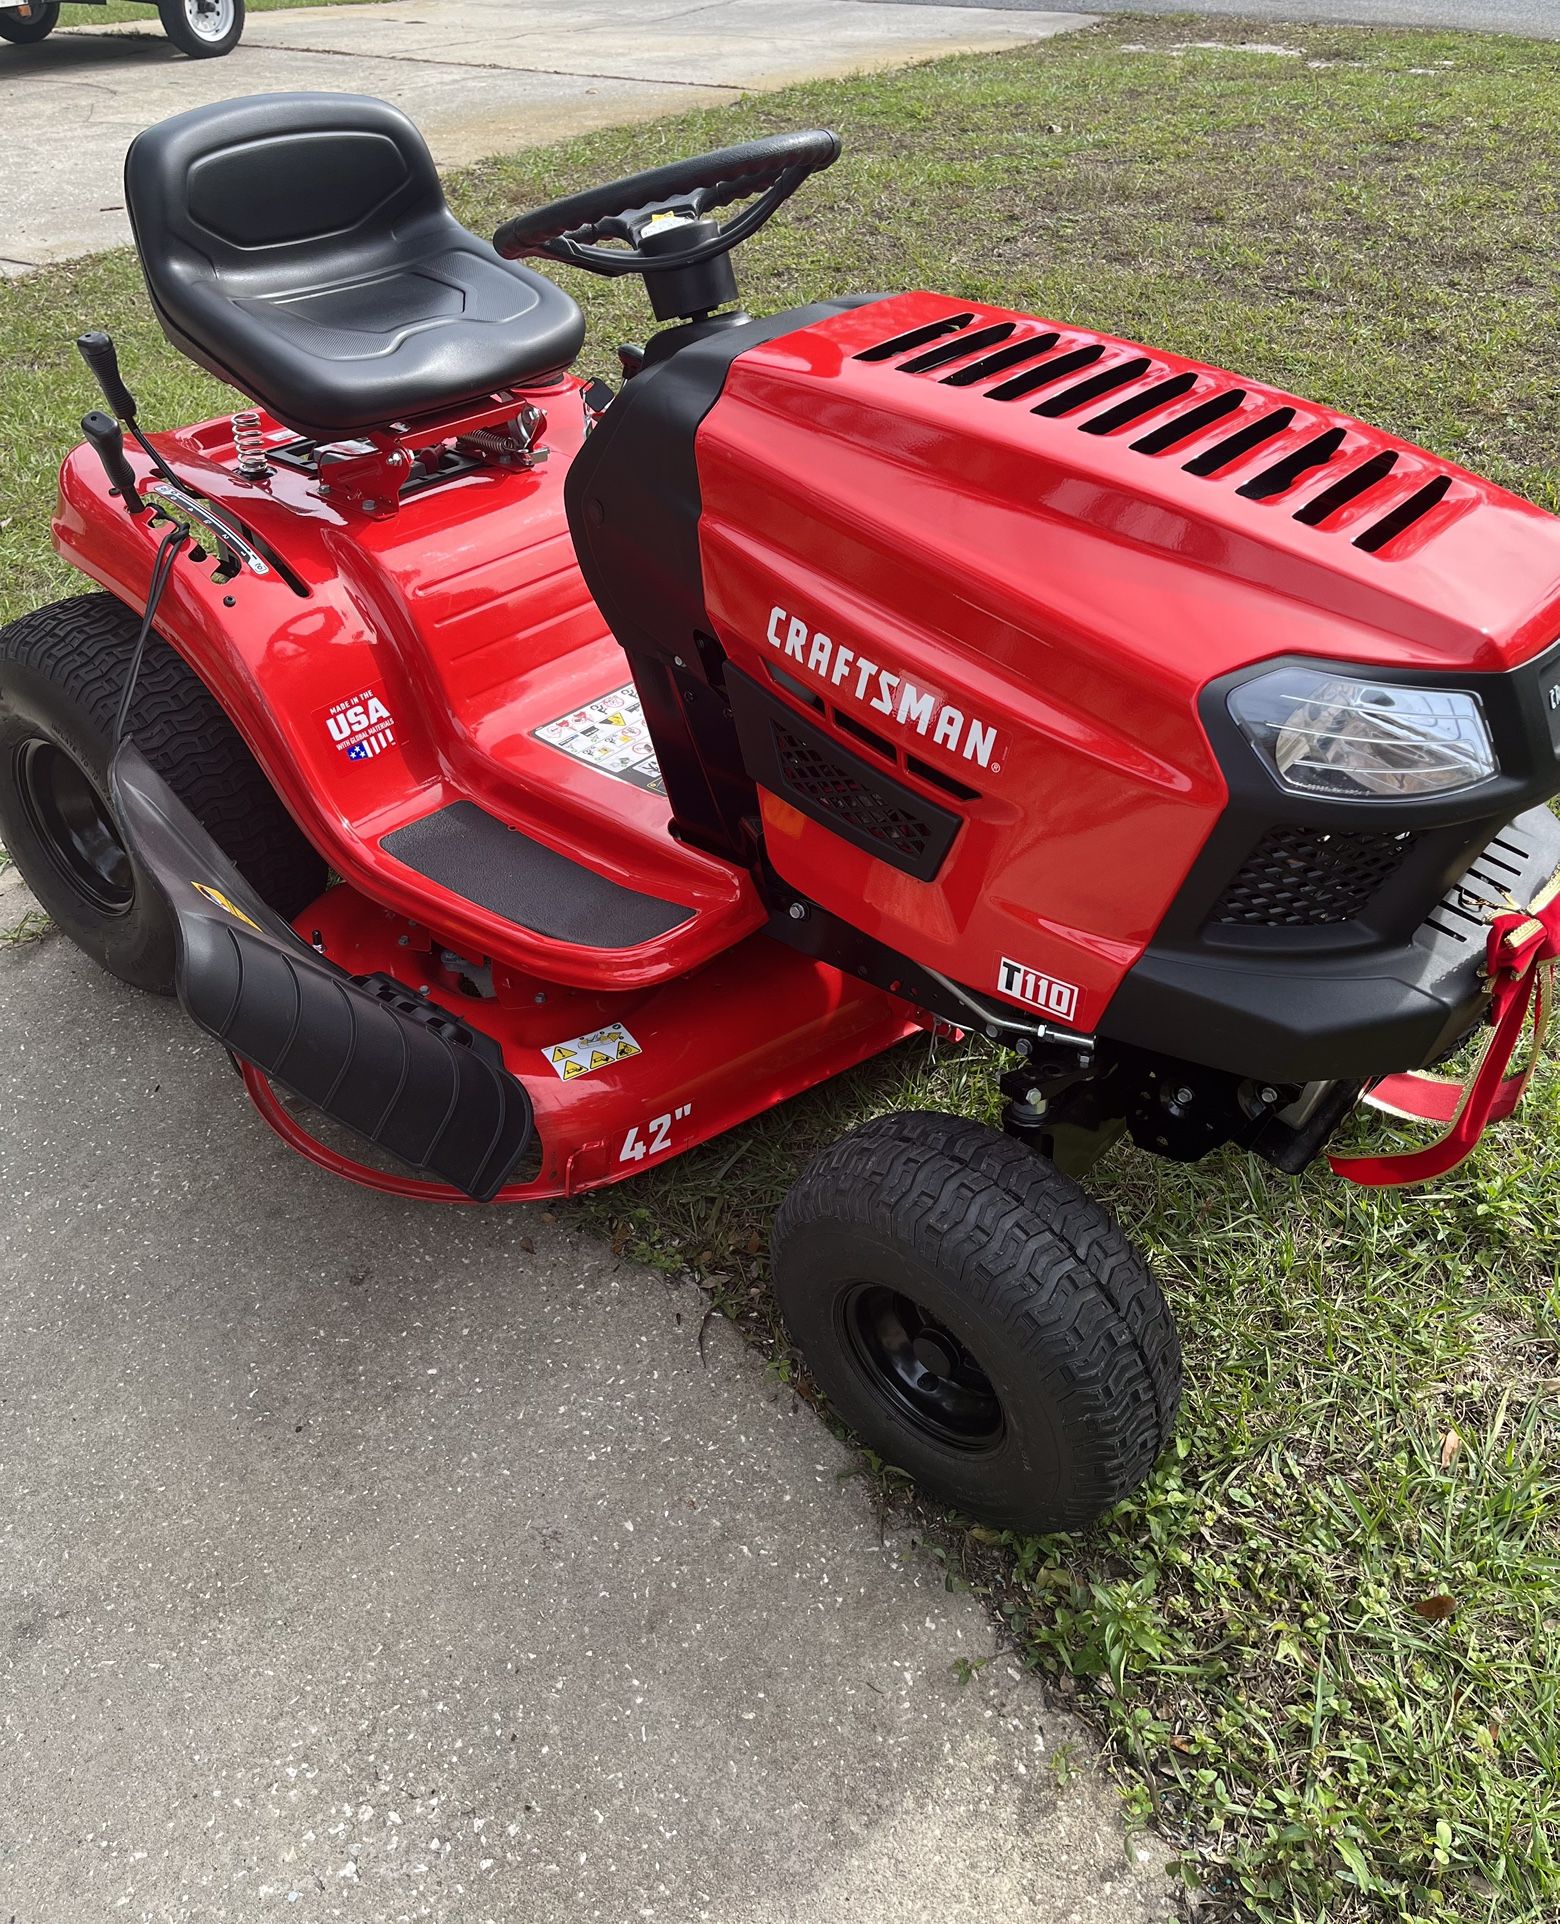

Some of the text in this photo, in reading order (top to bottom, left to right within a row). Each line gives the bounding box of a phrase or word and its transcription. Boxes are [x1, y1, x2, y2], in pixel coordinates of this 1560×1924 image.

[329, 689, 374, 715] MADE IN THE
[766, 606, 998, 769] CRAFTSMAN
[325, 697, 391, 742] USA
[336, 718, 394, 751] WITH GLOBAL MATERIALS
[1003, 961, 1071, 1014] T110
[619, 1103, 692, 1162] 42"
